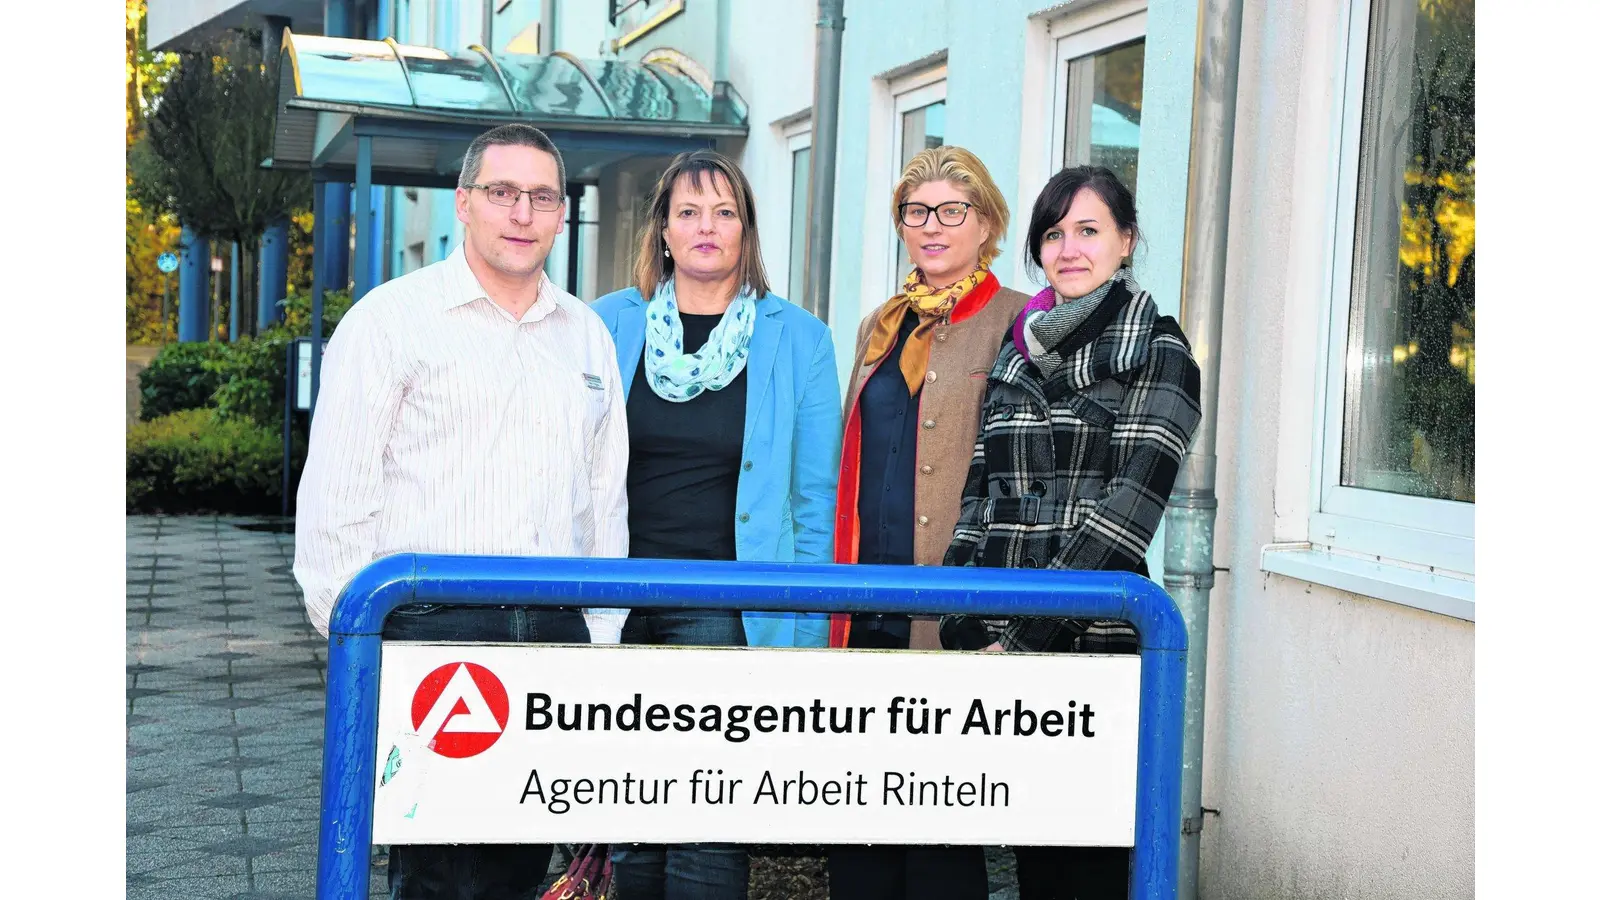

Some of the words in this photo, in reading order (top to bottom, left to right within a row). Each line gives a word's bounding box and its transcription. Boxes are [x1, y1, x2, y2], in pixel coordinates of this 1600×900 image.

[525, 692, 876, 743] Bundesagentur
[887, 696, 952, 736] für
[960, 698, 1096, 738] Arbeit
[519, 769, 678, 815] Agentur
[690, 769, 744, 805] für
[753, 770, 869, 806] Arbeit
[883, 771, 1010, 807] Rinteln
